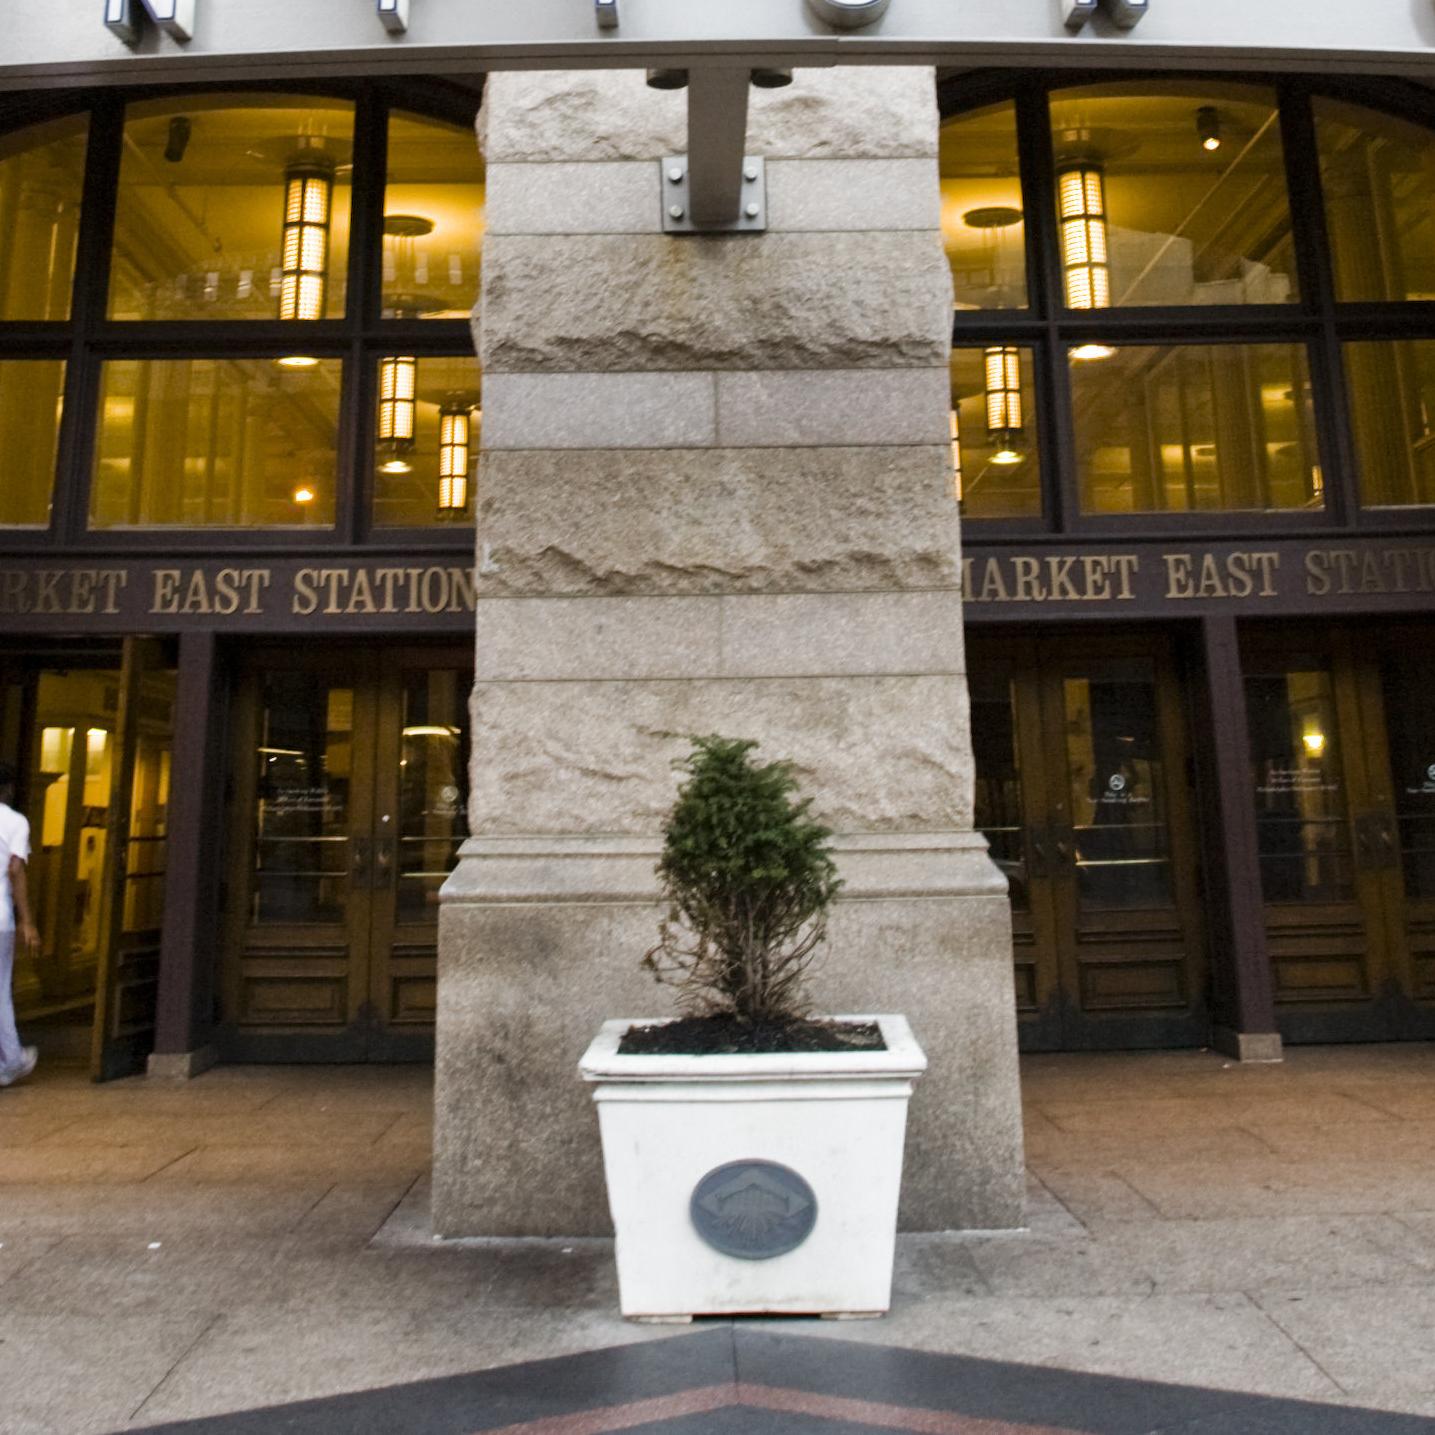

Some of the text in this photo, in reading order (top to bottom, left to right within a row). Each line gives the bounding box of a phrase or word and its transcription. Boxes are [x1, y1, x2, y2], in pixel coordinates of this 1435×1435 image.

[148, 567, 270, 615] EAST
[292, 565, 477, 615] STATION
[1163, 551, 1280, 600] EAST
